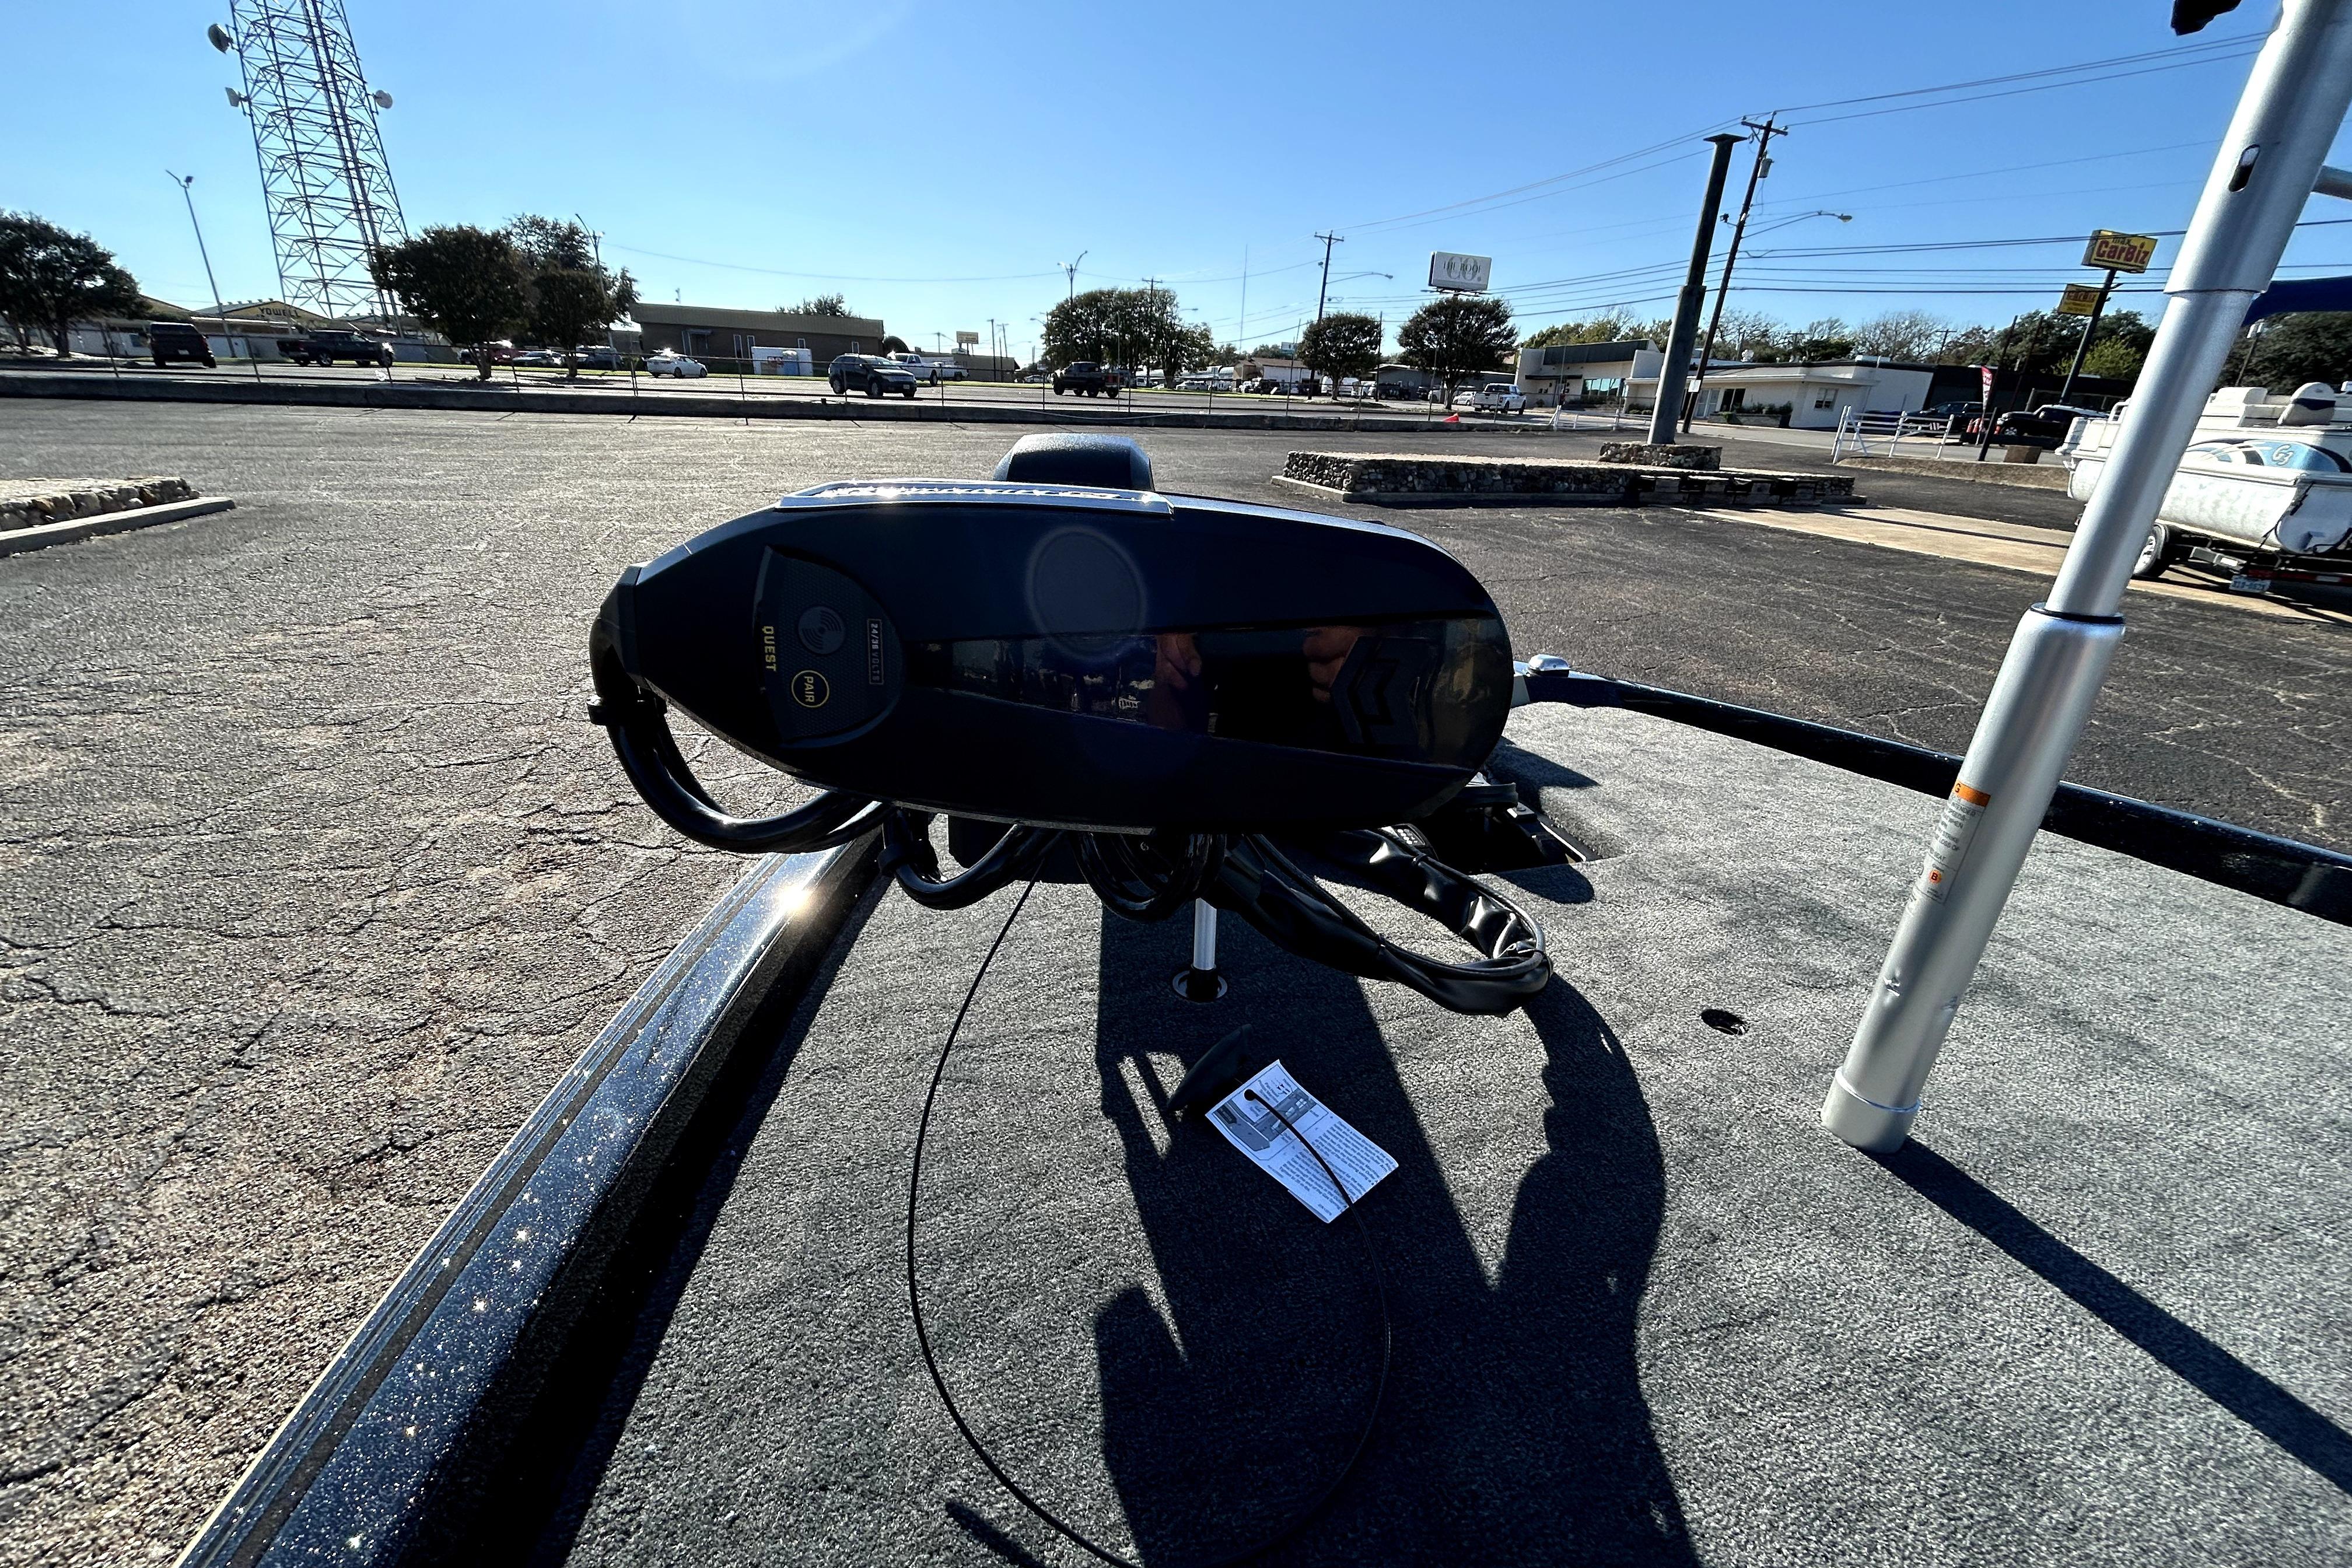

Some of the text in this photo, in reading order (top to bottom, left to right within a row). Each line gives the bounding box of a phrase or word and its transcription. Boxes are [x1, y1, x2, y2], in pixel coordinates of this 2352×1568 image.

[2096, 240, 2150, 264] CarBiz
[2272, 443, 2294, 466] G3
[761, 625, 776, 671] QUEST
[803, 676, 815, 702] PAIR
